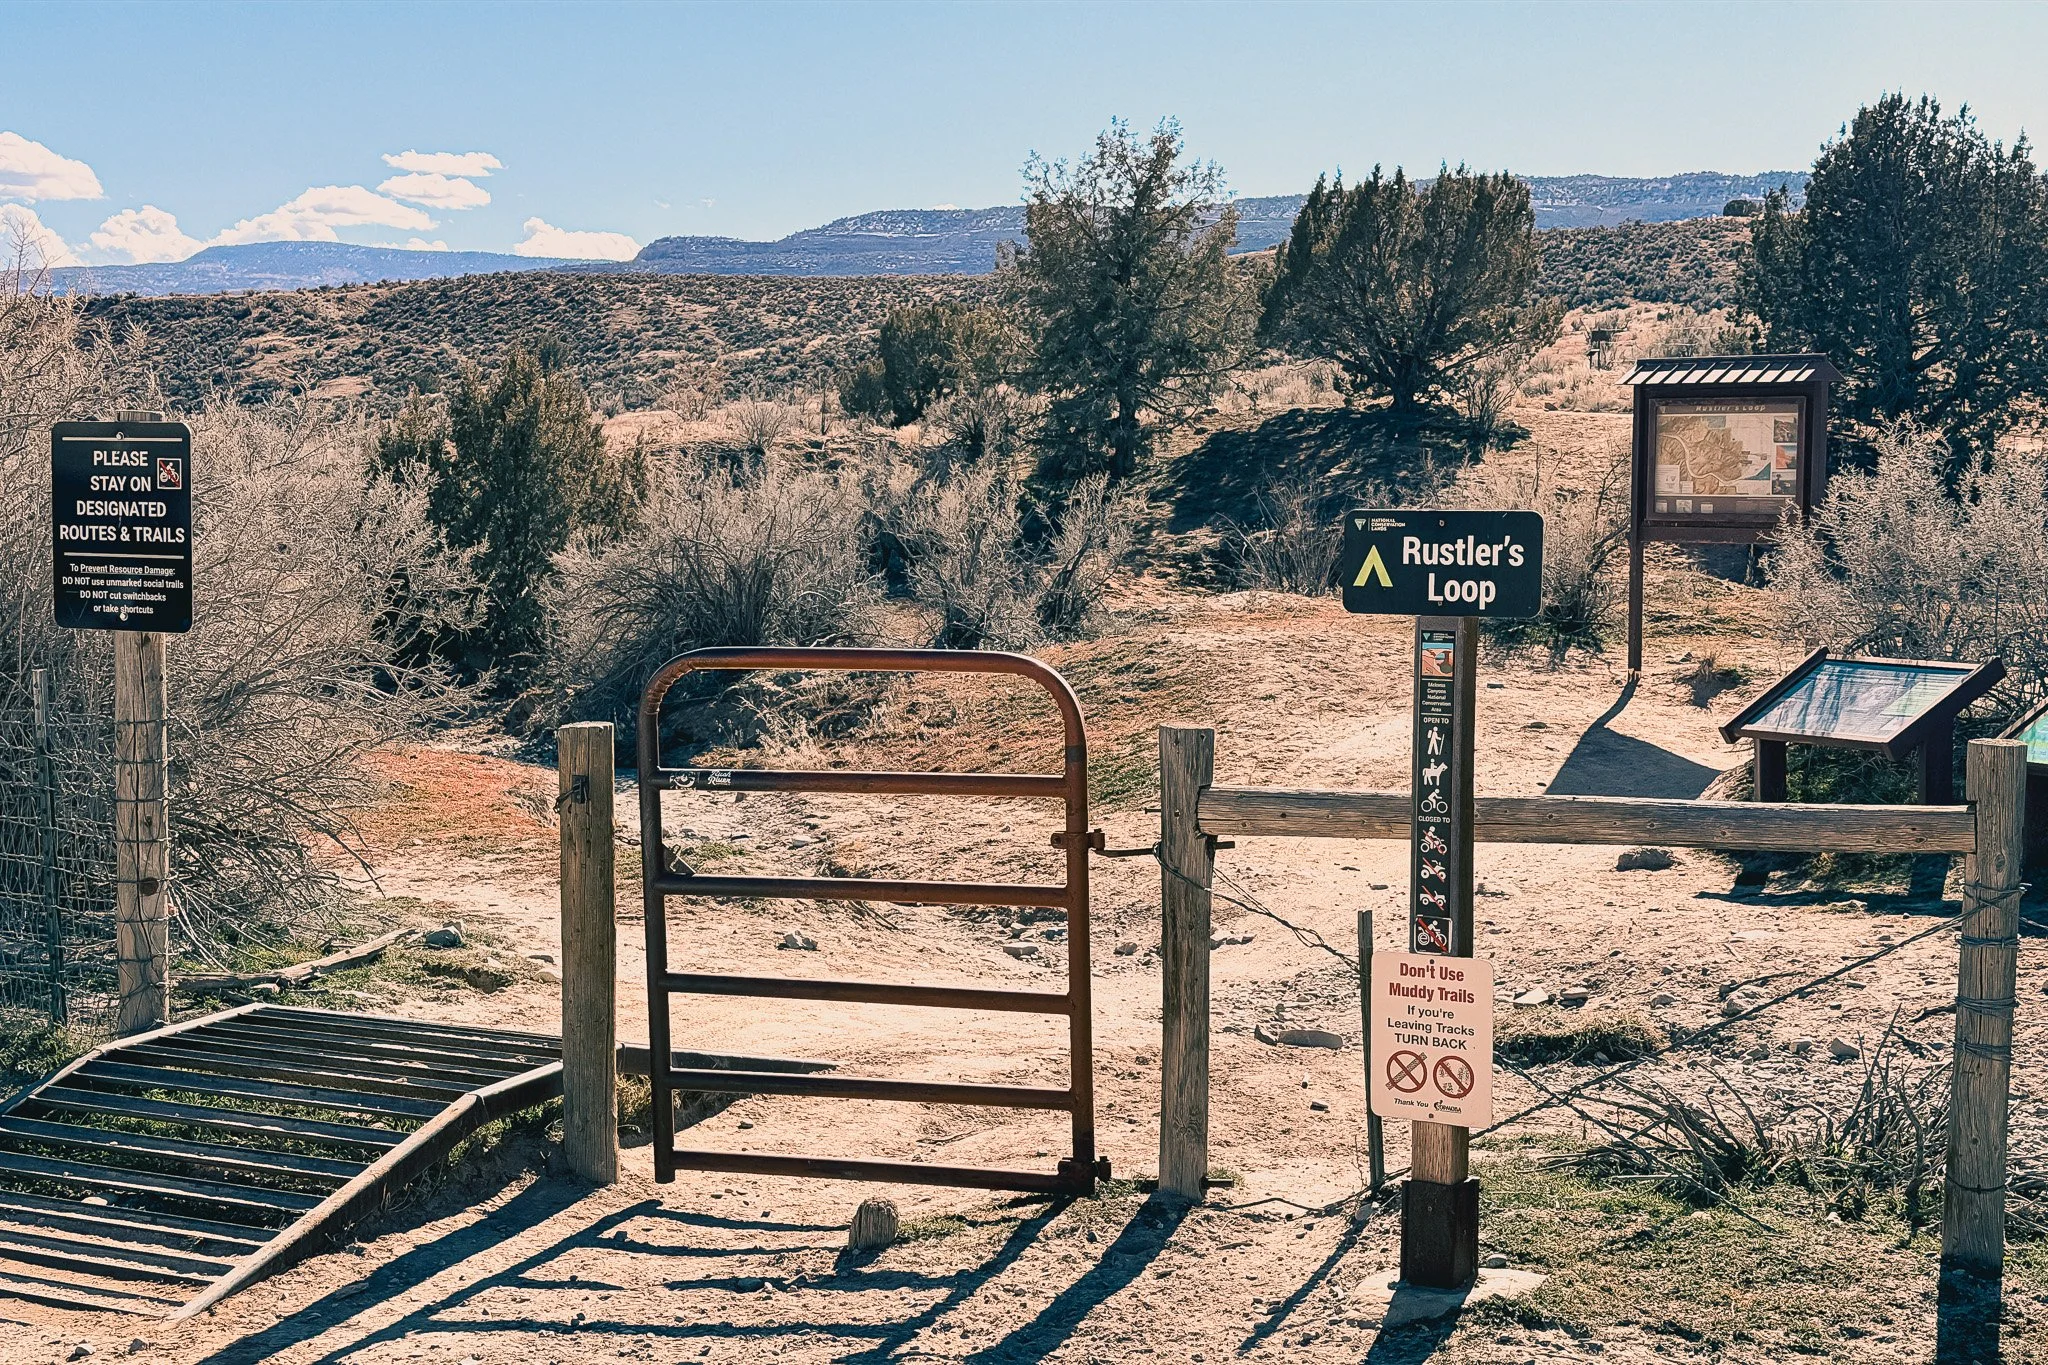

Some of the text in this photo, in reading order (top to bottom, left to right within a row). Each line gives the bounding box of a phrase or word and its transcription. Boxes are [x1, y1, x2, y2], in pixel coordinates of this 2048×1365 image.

[93, 450, 149, 467] PLEASE
[90, 475, 152, 492] STAY ON
[76, 500, 167, 517] DESIGNATED
[60, 524, 185, 543] ROUTES & TRAILS
[1402, 535, 1525, 567] Rustler's
[70, 563, 176, 576] To Prevent Resource Damage:
[62, 576, 73, 585] DO
[75, 577, 90, 586] NOT
[106, 578, 142, 587] unmarked
[143, 580, 164, 588] social
[166, 580, 184, 589] trails
[1428, 572, 1496, 610] Loop
[80, 591, 167, 602] DO NOT cut switchbacks
[102, 604, 119, 613] take
[120, 605, 154, 614] shortcuts
[1418, 815, 1451, 824] CLOSED TO
[1400, 962, 1465, 982] Don't Use
[1389, 982, 1475, 1004] Muddy Trails
[1407, 1005, 1455, 1019] If you're
[1387, 1018, 1475, 1036] Leaving Tracks
[1394, 1033, 1467, 1051] TURN BACK
[1394, 1098, 1415, 1106] Thank
